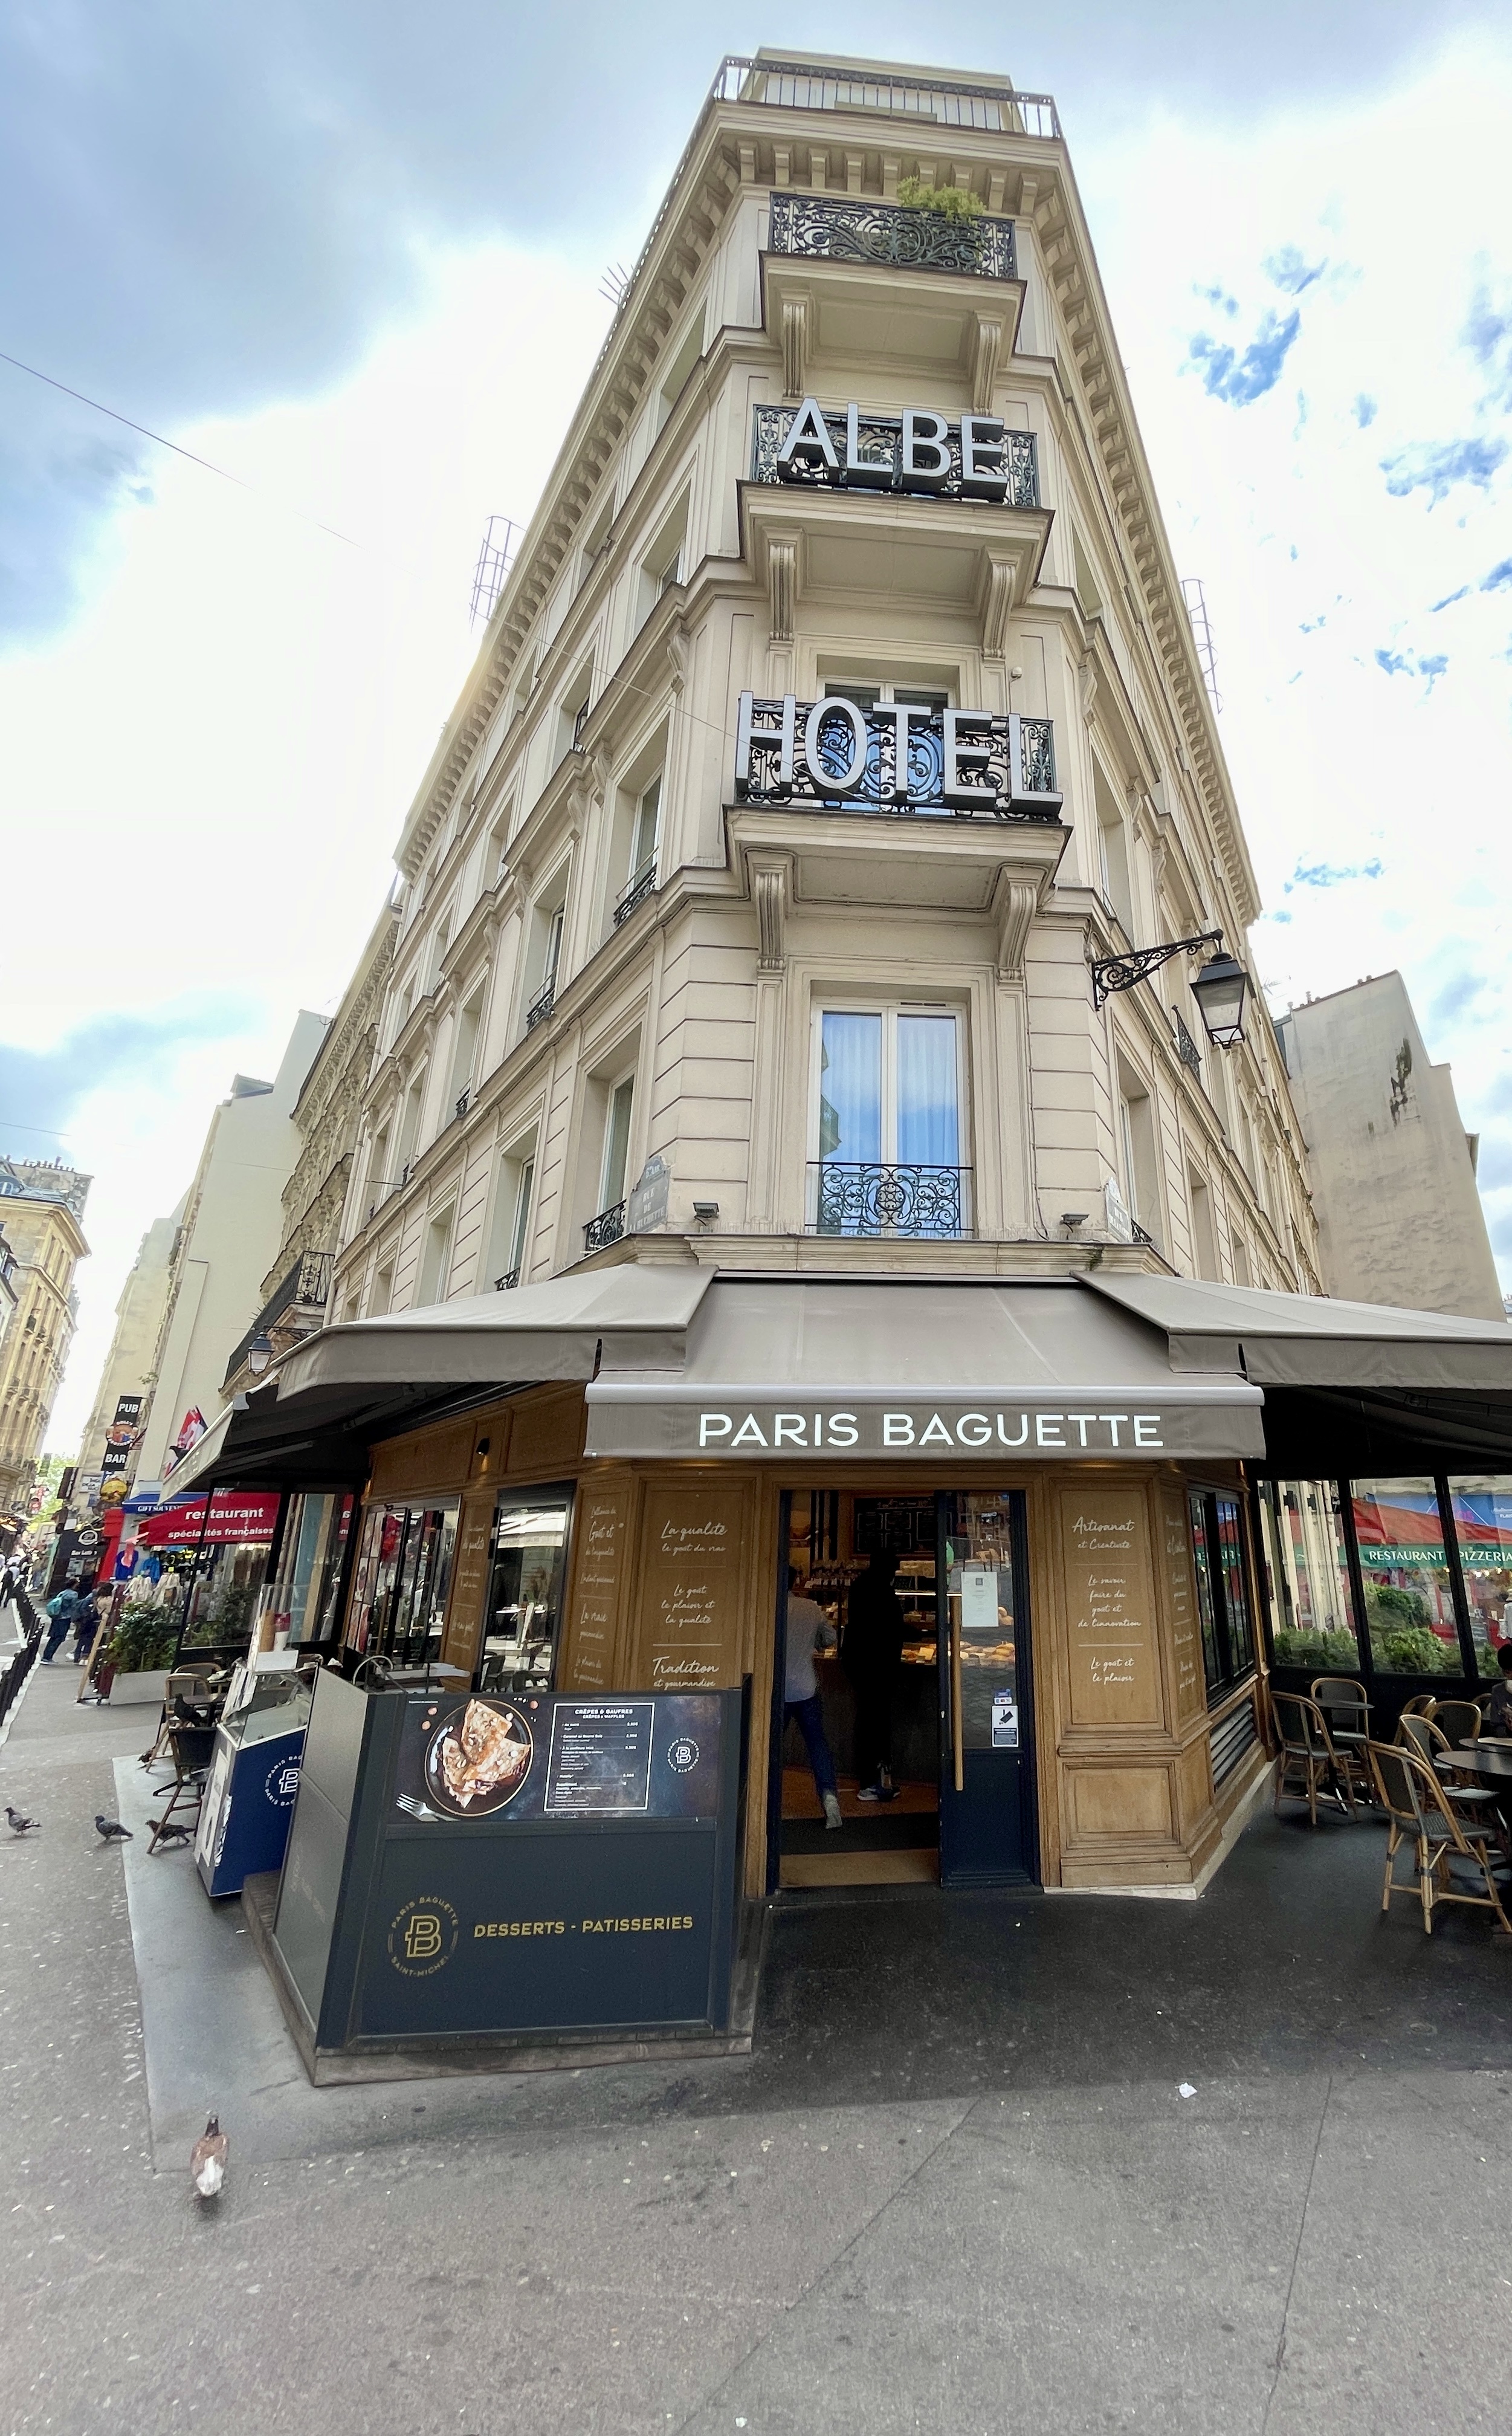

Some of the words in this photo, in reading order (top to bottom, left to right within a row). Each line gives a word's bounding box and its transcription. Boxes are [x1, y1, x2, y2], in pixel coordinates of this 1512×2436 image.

[778, 397, 1008, 485] ALBE
[735, 691, 1062, 805] HOTEL
[118, 1403, 138, 1413] PUB
[699, 1413, 859, 1447] PARIS
[883, 1412, 1164, 1447] BAGUETTE
[105, 1453, 126, 1463] BAR
[660, 1520, 679, 1538] La
[1071, 1516, 1135, 1535] Artisanat
[168, 1527, 222, 1540] spéciaités
[224, 1526, 274, 1537] françaises
[662, 1543, 671, 1552] le
[1077, 1540, 1088, 1549] et
[1368, 1550, 1444, 1561] RESTAURANT
[1459, 1550, 1512, 1561] PIZZERIA
[1088, 1574, 1097, 1586] Le
[673, 1584, 685, 1597] Le
[1089, 1589, 1111, 1602] faire
[661, 1599, 671, 1609] le
[671, 1599, 703, 1612] plaisir
[705, 1600, 716, 1609] et
[1112, 1604, 1122, 1613] et
[665, 1614, 677, 1624] la
[1077, 1618, 1089, 1627] de
[652, 1656, 719, 1676] Tradition
[1091, 1656, 1101, 1670] Le
[1124, 1657, 1135, 1667] et
[653, 1678, 664, 1688] et
[664, 1677, 716, 1691] gourmandise
[1093, 1672, 1102, 1682] le
[1103, 1672, 1136, 1685] plaisir
[391, 1901, 416, 1929] PARIS
[419, 1896, 459, 1926] BAGUETTE
[473, 1921, 565, 1939] DESSERTS
[581, 1916, 694, 1933] PATISSERIES
[391, 1955, 450, 1977] SAINT-MICHEL
